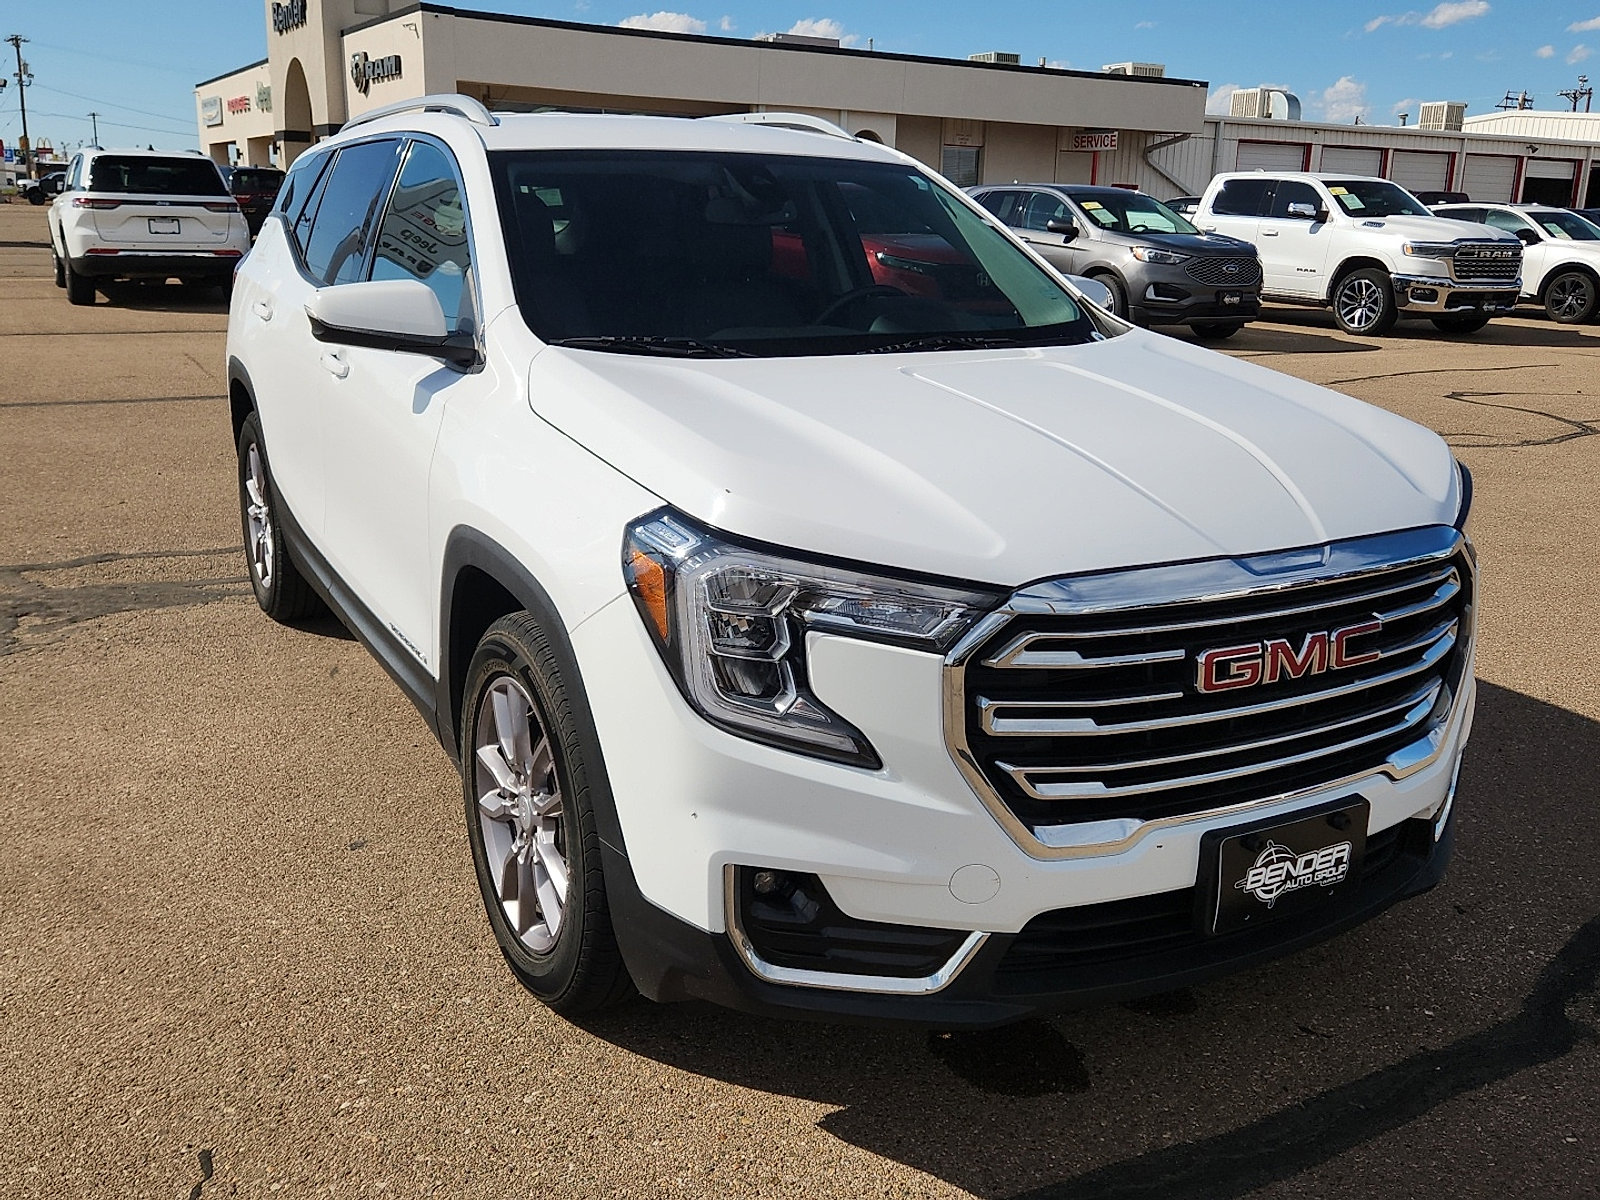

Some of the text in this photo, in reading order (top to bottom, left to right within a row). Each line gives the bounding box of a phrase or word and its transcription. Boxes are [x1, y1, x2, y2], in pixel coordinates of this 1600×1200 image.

[272, 0, 304, 32] Bender
[365, 55, 399, 79] RAM
[1073, 134, 1117, 149] SERVICE
[1480, 250, 1513, 258] RAM
[1195, 620, 1382, 694] GMC
[1246, 843, 1350, 890] BENDER
[1285, 873, 1314, 891] AUTO
[1313, 863, 1347, 882] GROUP
